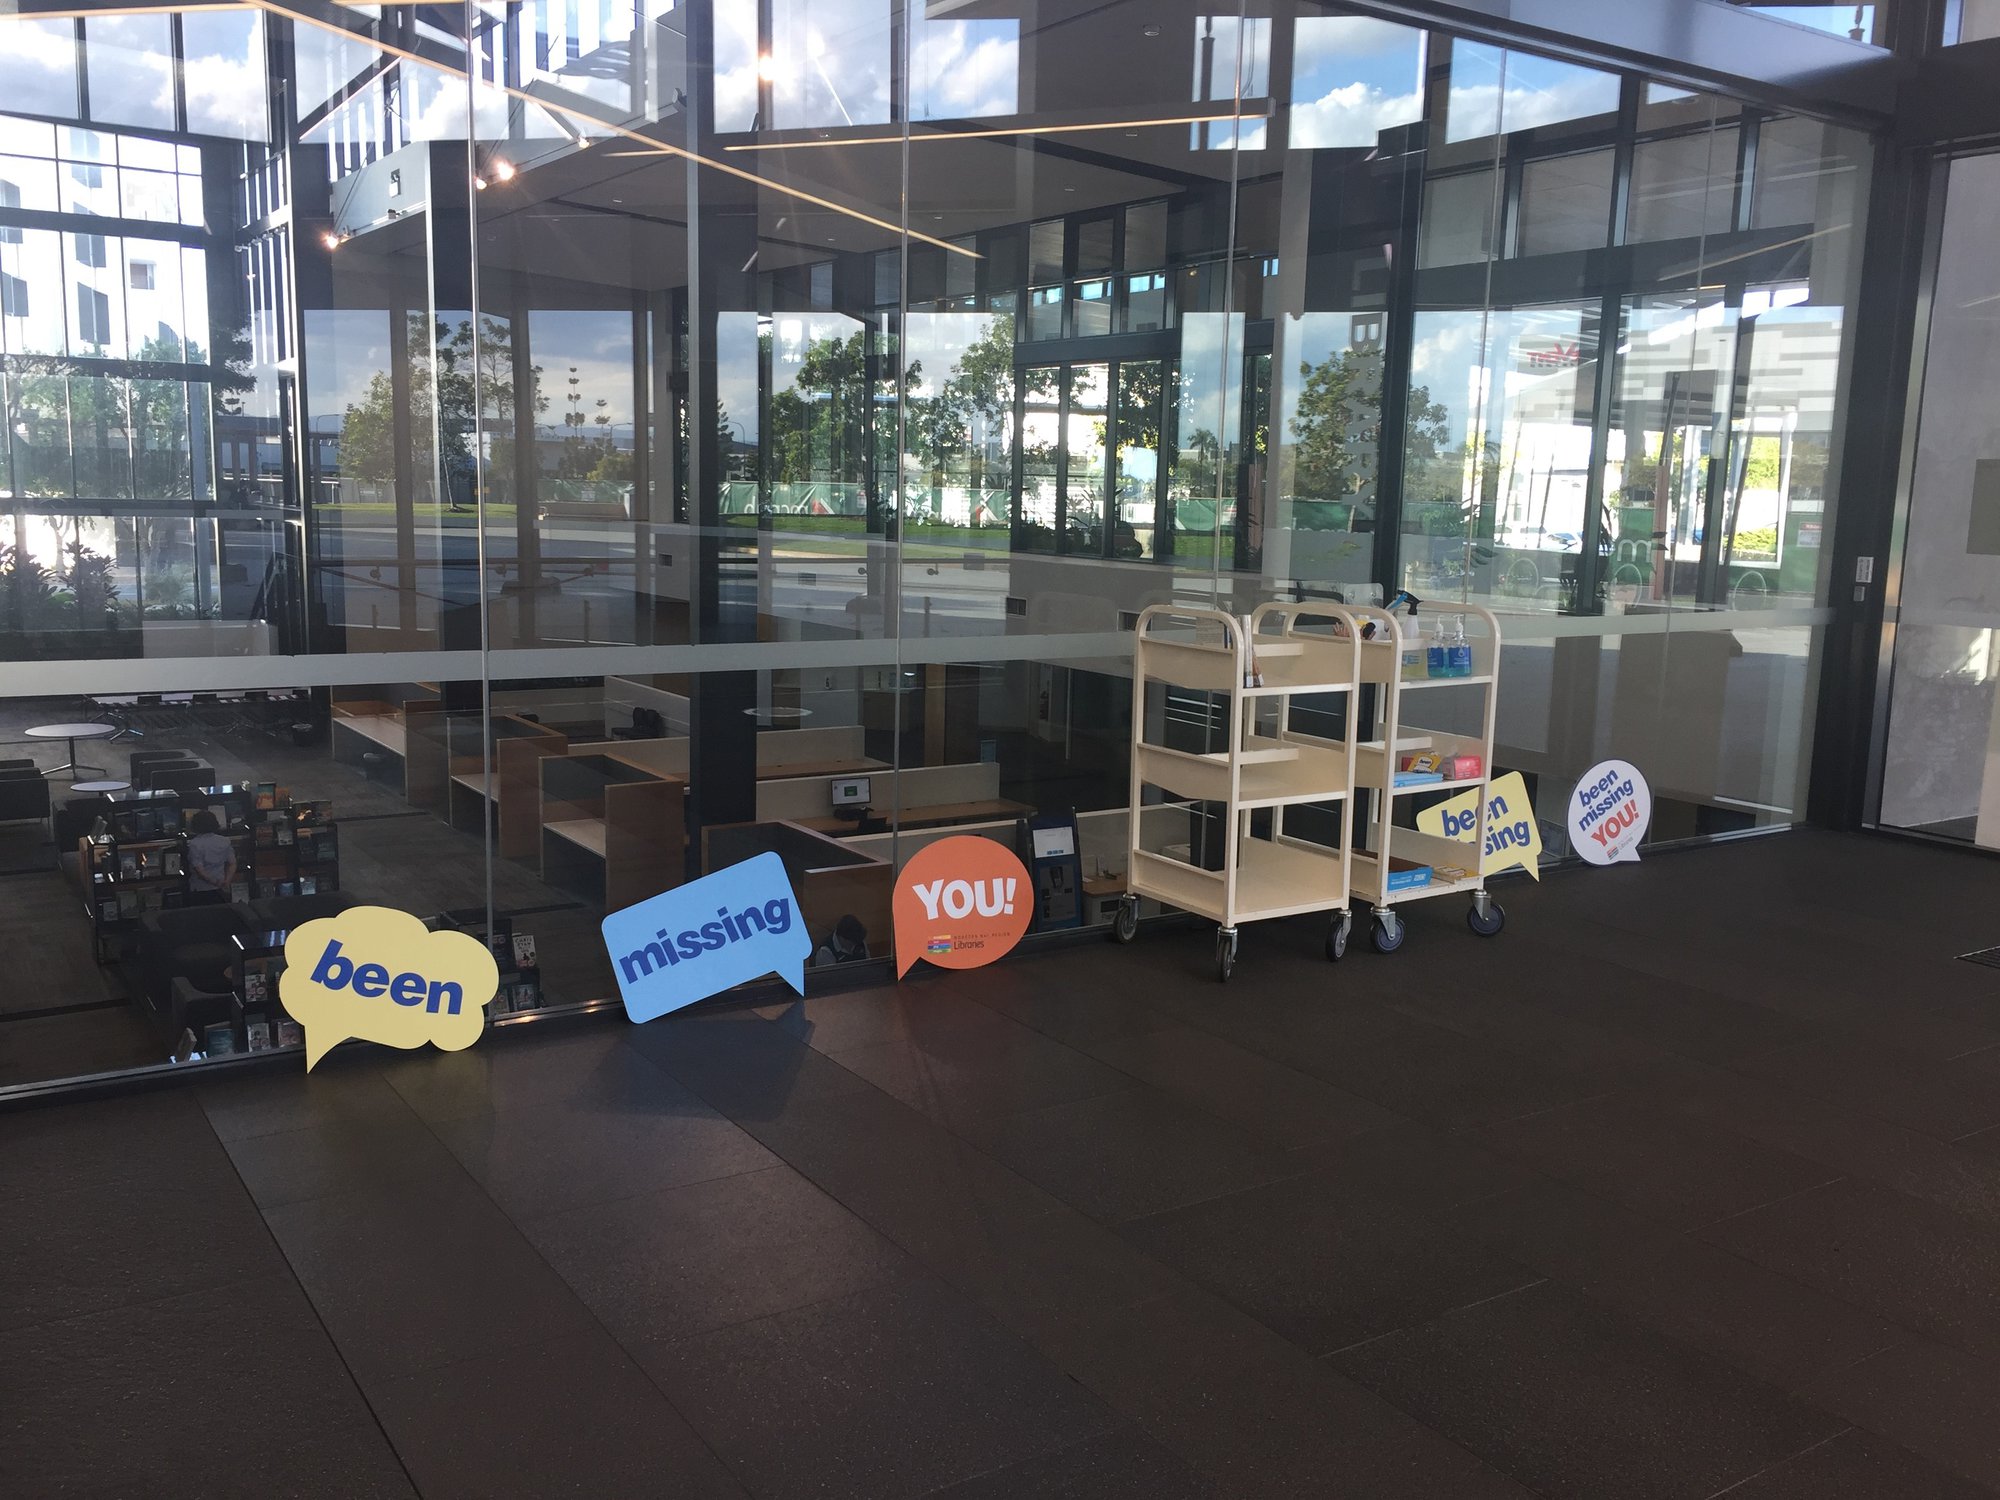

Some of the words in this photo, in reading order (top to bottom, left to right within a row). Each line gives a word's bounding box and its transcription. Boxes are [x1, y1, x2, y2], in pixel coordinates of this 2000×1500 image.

[1578, 779, 1634, 832] missing
[1579, 769, 1619, 807] been
[1591, 799, 1640, 847] YOU!
[912, 878, 1017, 920] YOU!
[619, 896, 792, 984] missing
[954, 940, 985, 950] Libraries
[310, 939, 464, 1015] been
